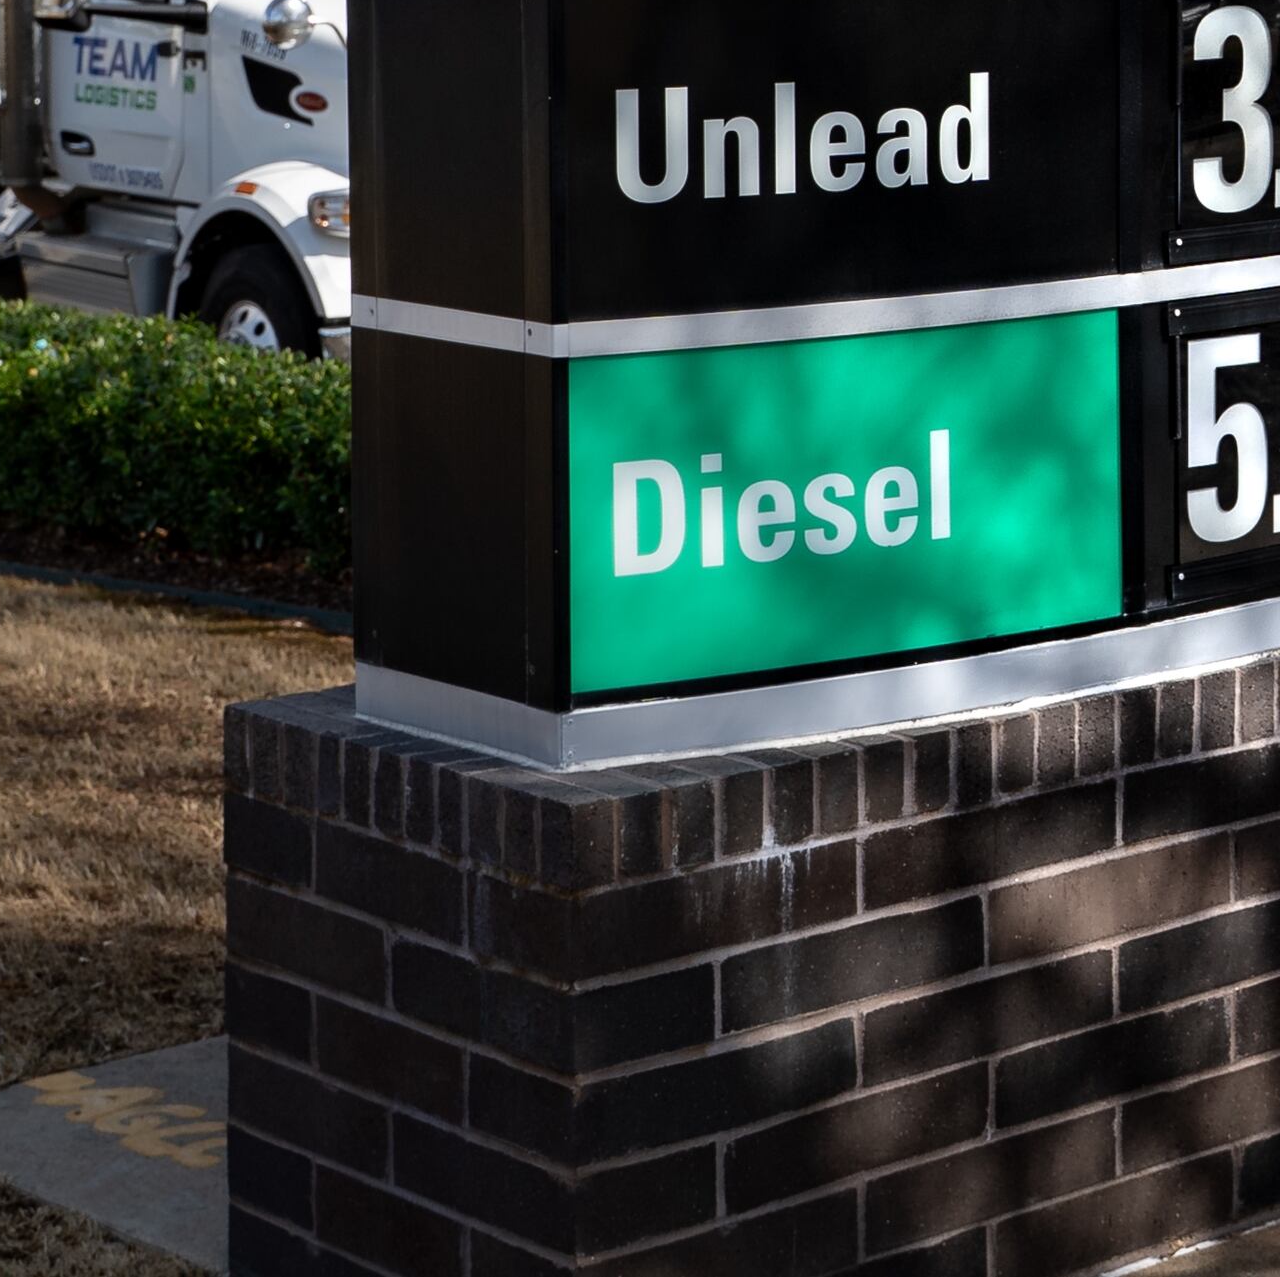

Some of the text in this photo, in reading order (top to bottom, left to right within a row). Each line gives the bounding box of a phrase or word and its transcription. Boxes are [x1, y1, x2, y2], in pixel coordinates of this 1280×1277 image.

[73, 36, 157, 82] TEAM
[75, 83, 157, 111] LOGISTICS
[615, 72, 990, 204] Unlead
[612, 430, 951, 578] Diesel
